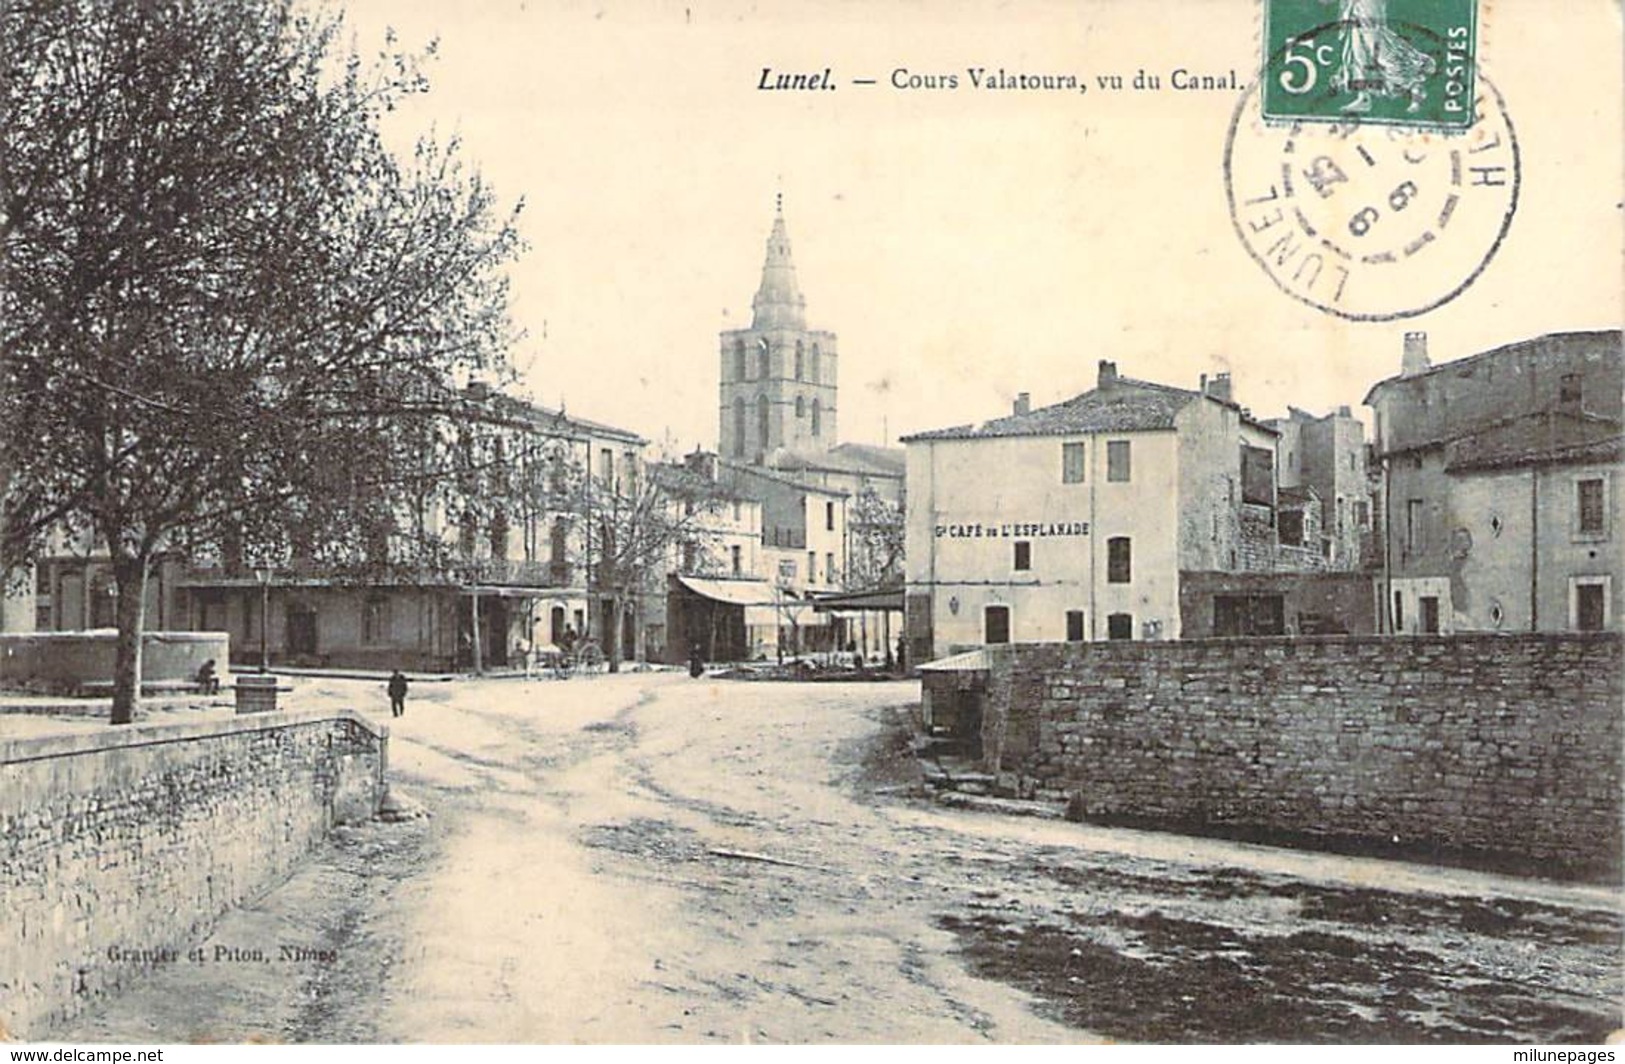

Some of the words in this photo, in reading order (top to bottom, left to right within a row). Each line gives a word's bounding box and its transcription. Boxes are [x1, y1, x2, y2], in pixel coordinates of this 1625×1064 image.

[1445, 26, 1468, 112] POSTES
[1244, 184, 1350, 302] LUNEL
[950, 522, 983, 538] CAFÉ
[1001, 522, 1090, 538] L'ESPLANADE
